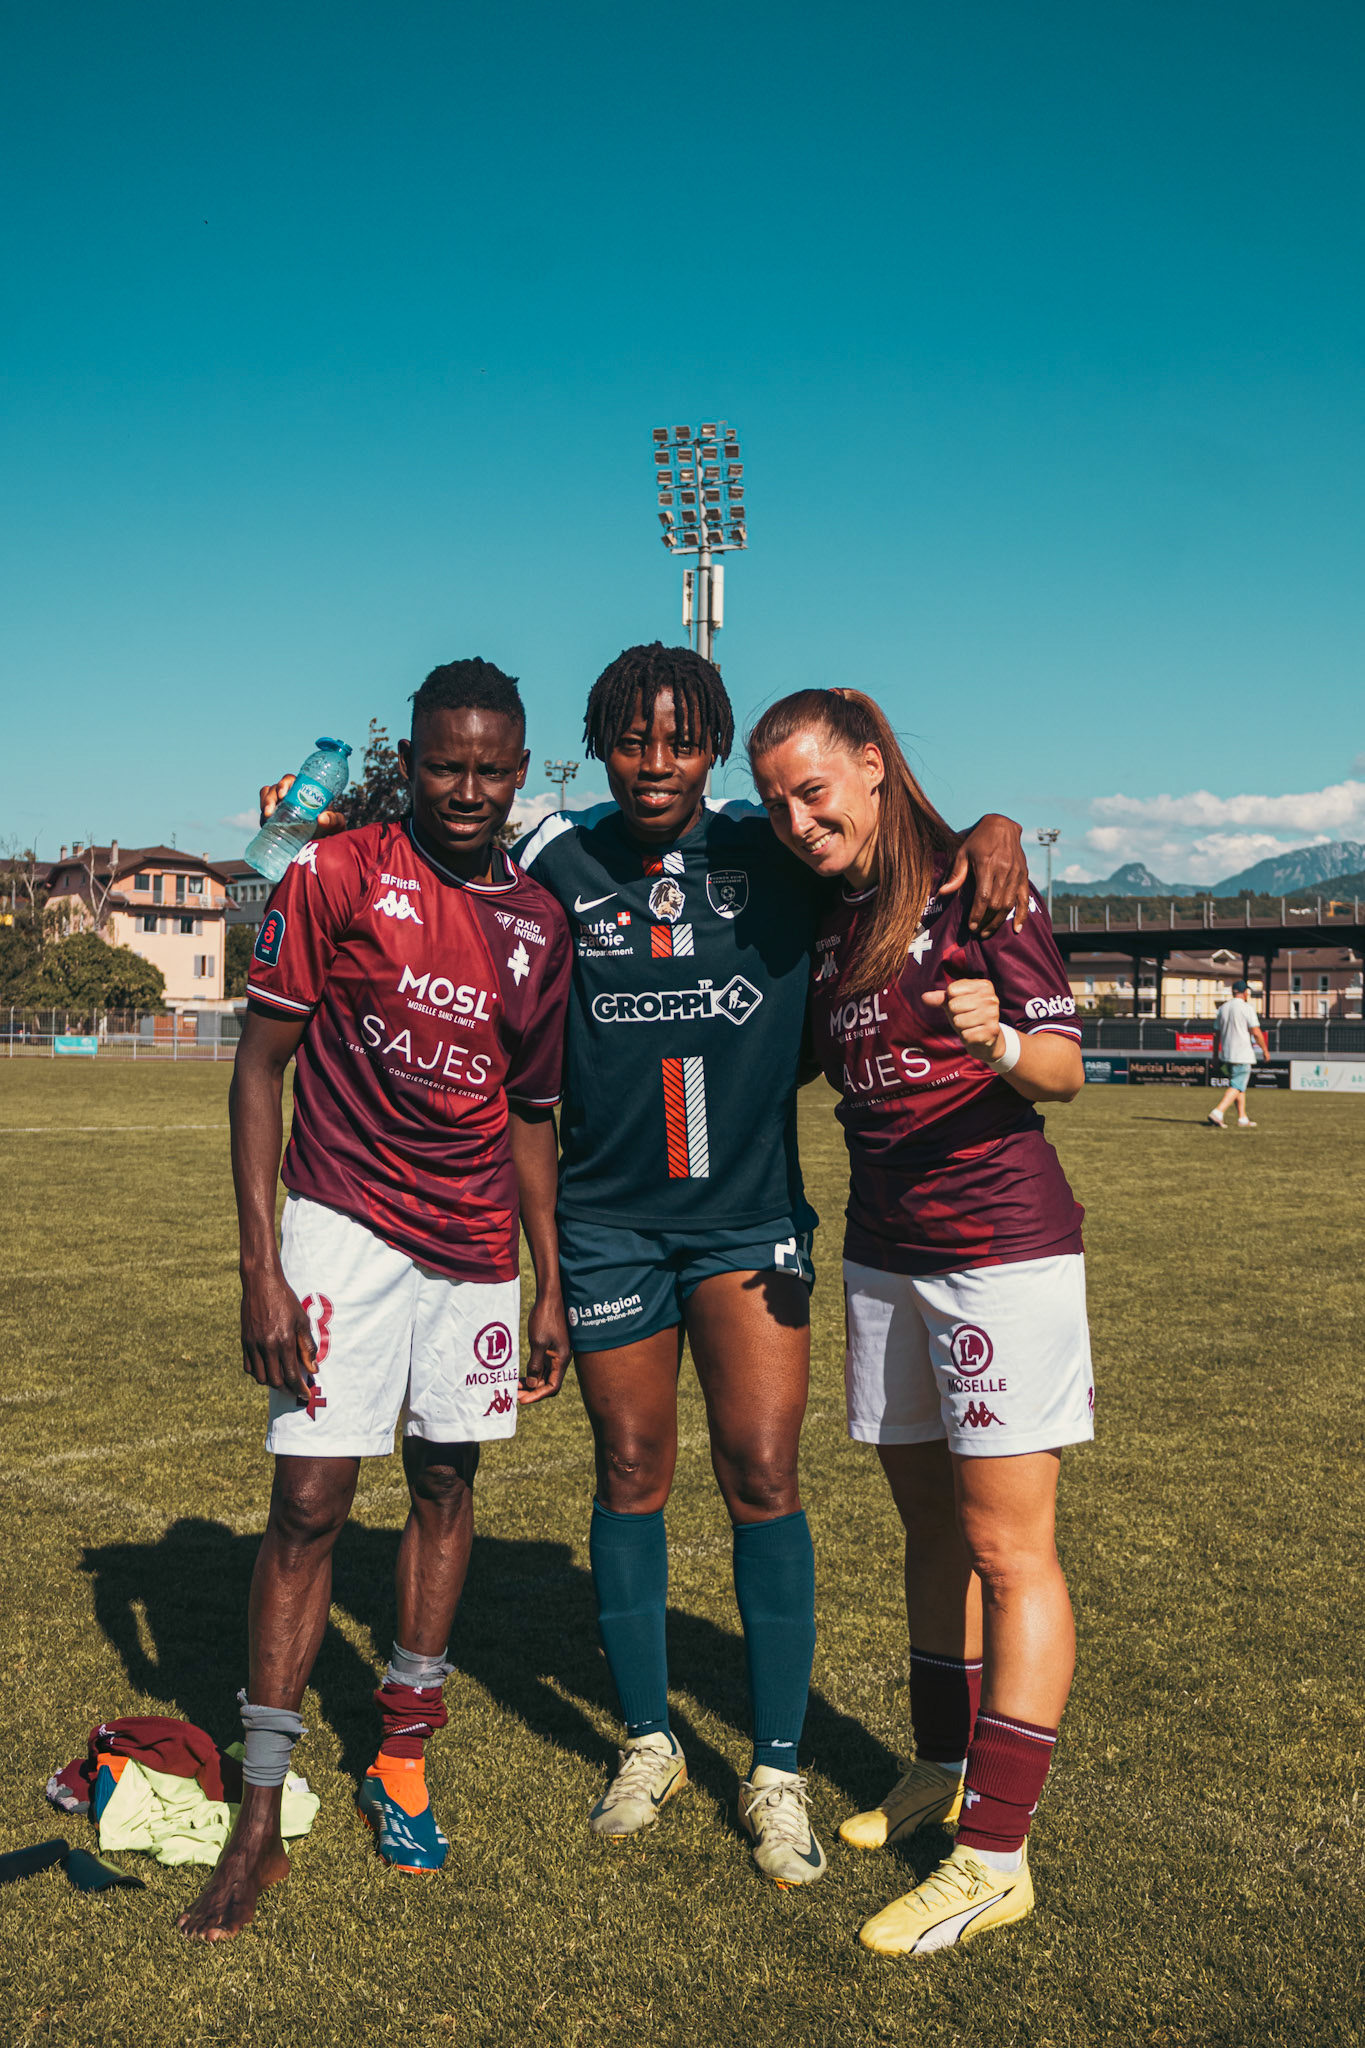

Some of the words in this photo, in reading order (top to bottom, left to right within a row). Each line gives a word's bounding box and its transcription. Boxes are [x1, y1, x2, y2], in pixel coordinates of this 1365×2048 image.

[516, 918, 541, 934] axia
[514, 926, 546, 946] INTERIM
[698, 979, 713, 989] TP
[593, 990, 714, 1022] GROPPI
[438, 1010, 454, 1022] SANS
[453, 1015, 476, 1029] LIMITE
[361, 1014, 491, 1084] SAJES
[843, 1047, 931, 1093] AJES
[1085, 1061, 1111, 1070] PARIS
[1166, 1063, 1205, 1076] Lingerie
[389, 1067, 445, 1090] CONCIERGERIE
[458, 1089, 488, 1102] ENTREPR
[1211, 1077, 1230, 1087] EUR
[1301, 1077, 1328, 1088] Evian
[579, 1306, 592, 1318] La
[593, 1294, 641, 1316] Région
[466, 1368, 518, 1386] MOSELLE
[947, 1378, 1008, 1393] MOSELLE
